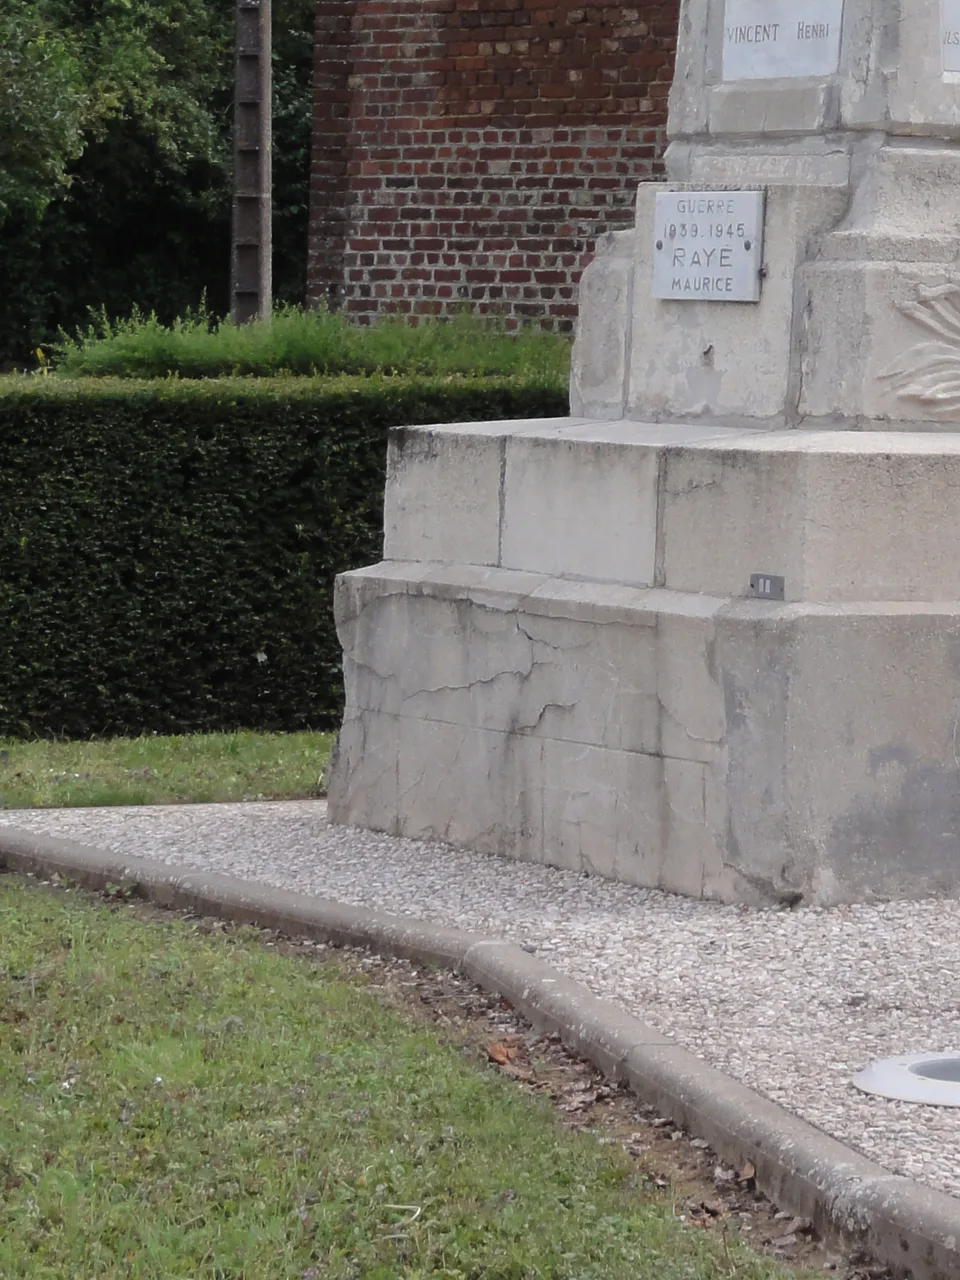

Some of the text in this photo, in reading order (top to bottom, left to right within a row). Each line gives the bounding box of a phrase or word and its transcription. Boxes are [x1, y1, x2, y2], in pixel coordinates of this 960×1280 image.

[727, 21, 829, 44] VINCENT HENRI
[943, 31, 960, 45] ILS
[677, 200, 734, 214] GUERRE
[671, 277, 733, 293] MAURICE
